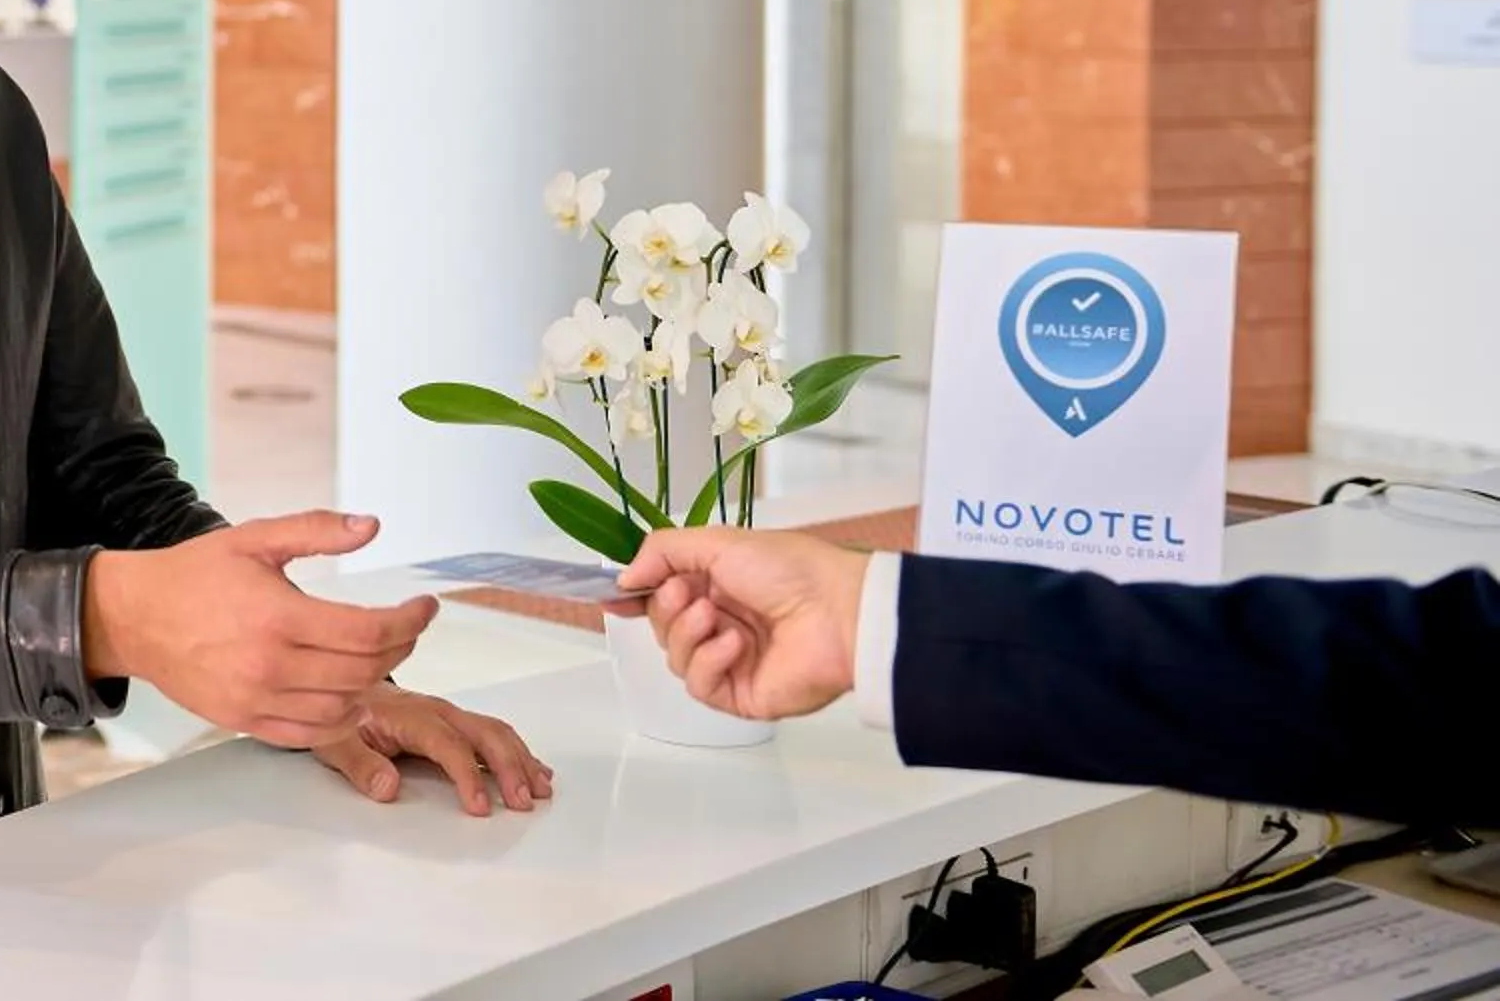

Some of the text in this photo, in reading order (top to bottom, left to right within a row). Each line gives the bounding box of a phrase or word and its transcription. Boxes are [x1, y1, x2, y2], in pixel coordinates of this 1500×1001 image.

[1032, 323, 1132, 342] #ALLSAFE
[955, 499, 1185, 544] NOVOTEL
[956, 531, 1186, 562] TORINO CORSO GIULIO CESARE
